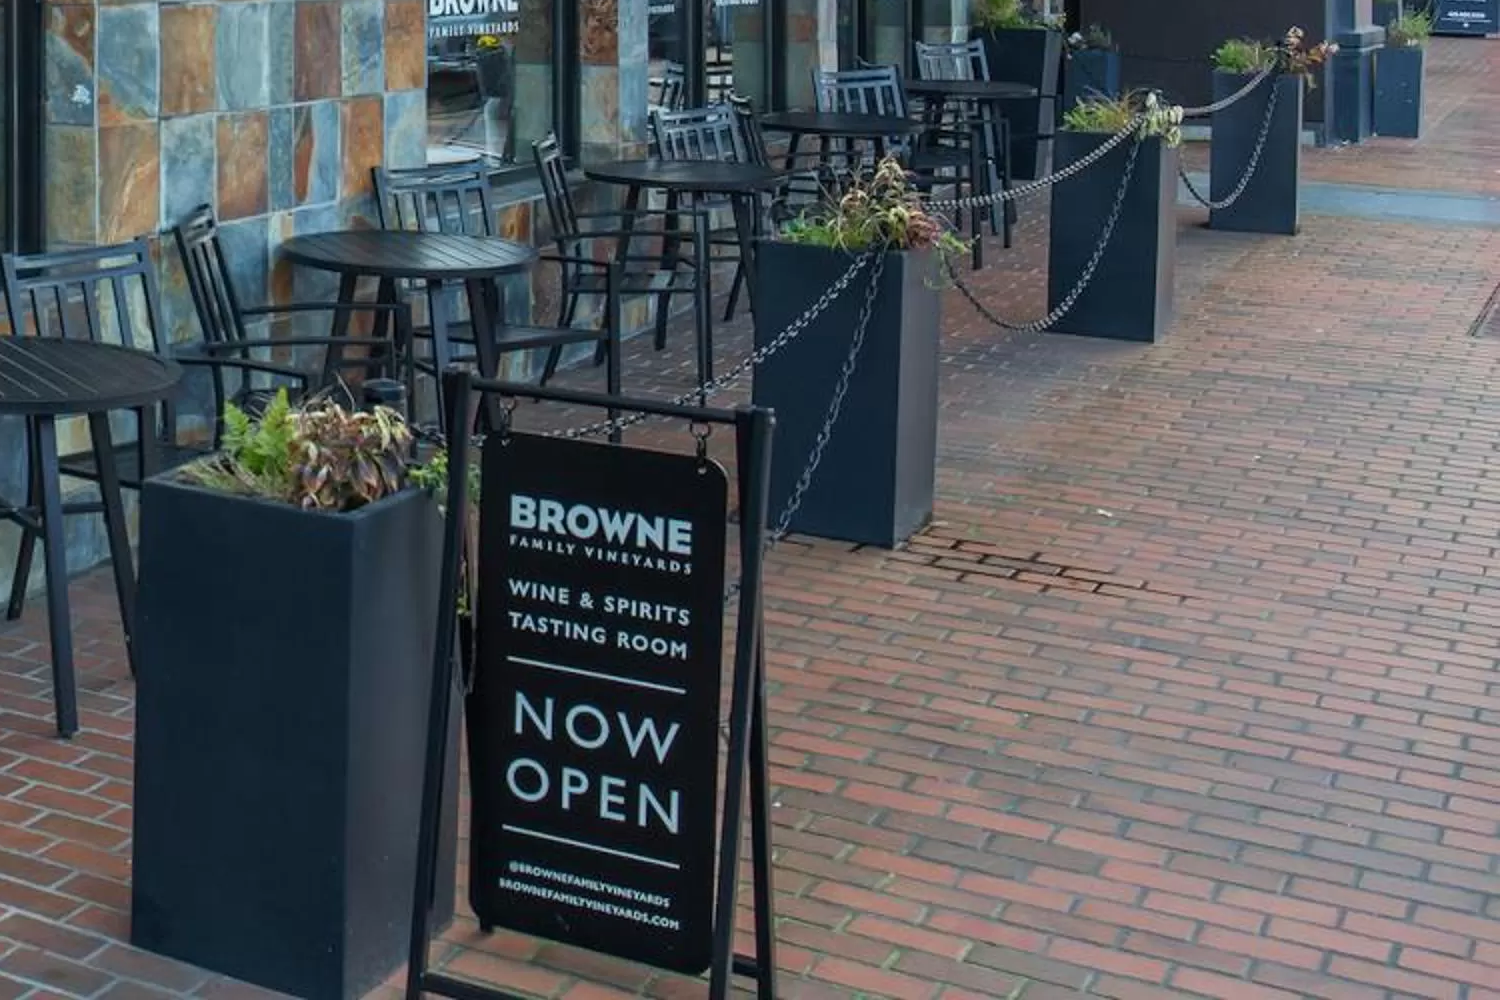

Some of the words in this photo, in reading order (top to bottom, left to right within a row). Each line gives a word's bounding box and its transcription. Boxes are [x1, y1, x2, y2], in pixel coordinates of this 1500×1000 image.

[510, 494, 693, 555] BROWNE
[509, 534, 576, 555] FAMILY
[585, 547, 693, 575] VINEYARDS
[508, 577, 570, 605] WINE
[580, 591, 594, 609] &
[604, 596, 691, 626] SPIRITS
[508, 611, 607, 644] TASTING
[617, 631, 688, 661] ROOM
[515, 689, 681, 765] NOW
[506, 757, 680, 835] OPEN
[499, 877, 681, 931] BROWNEFAMILYVINEYARDS.COM
[509, 860, 671, 908] @BROWNEFAMILYVINEYARDS
